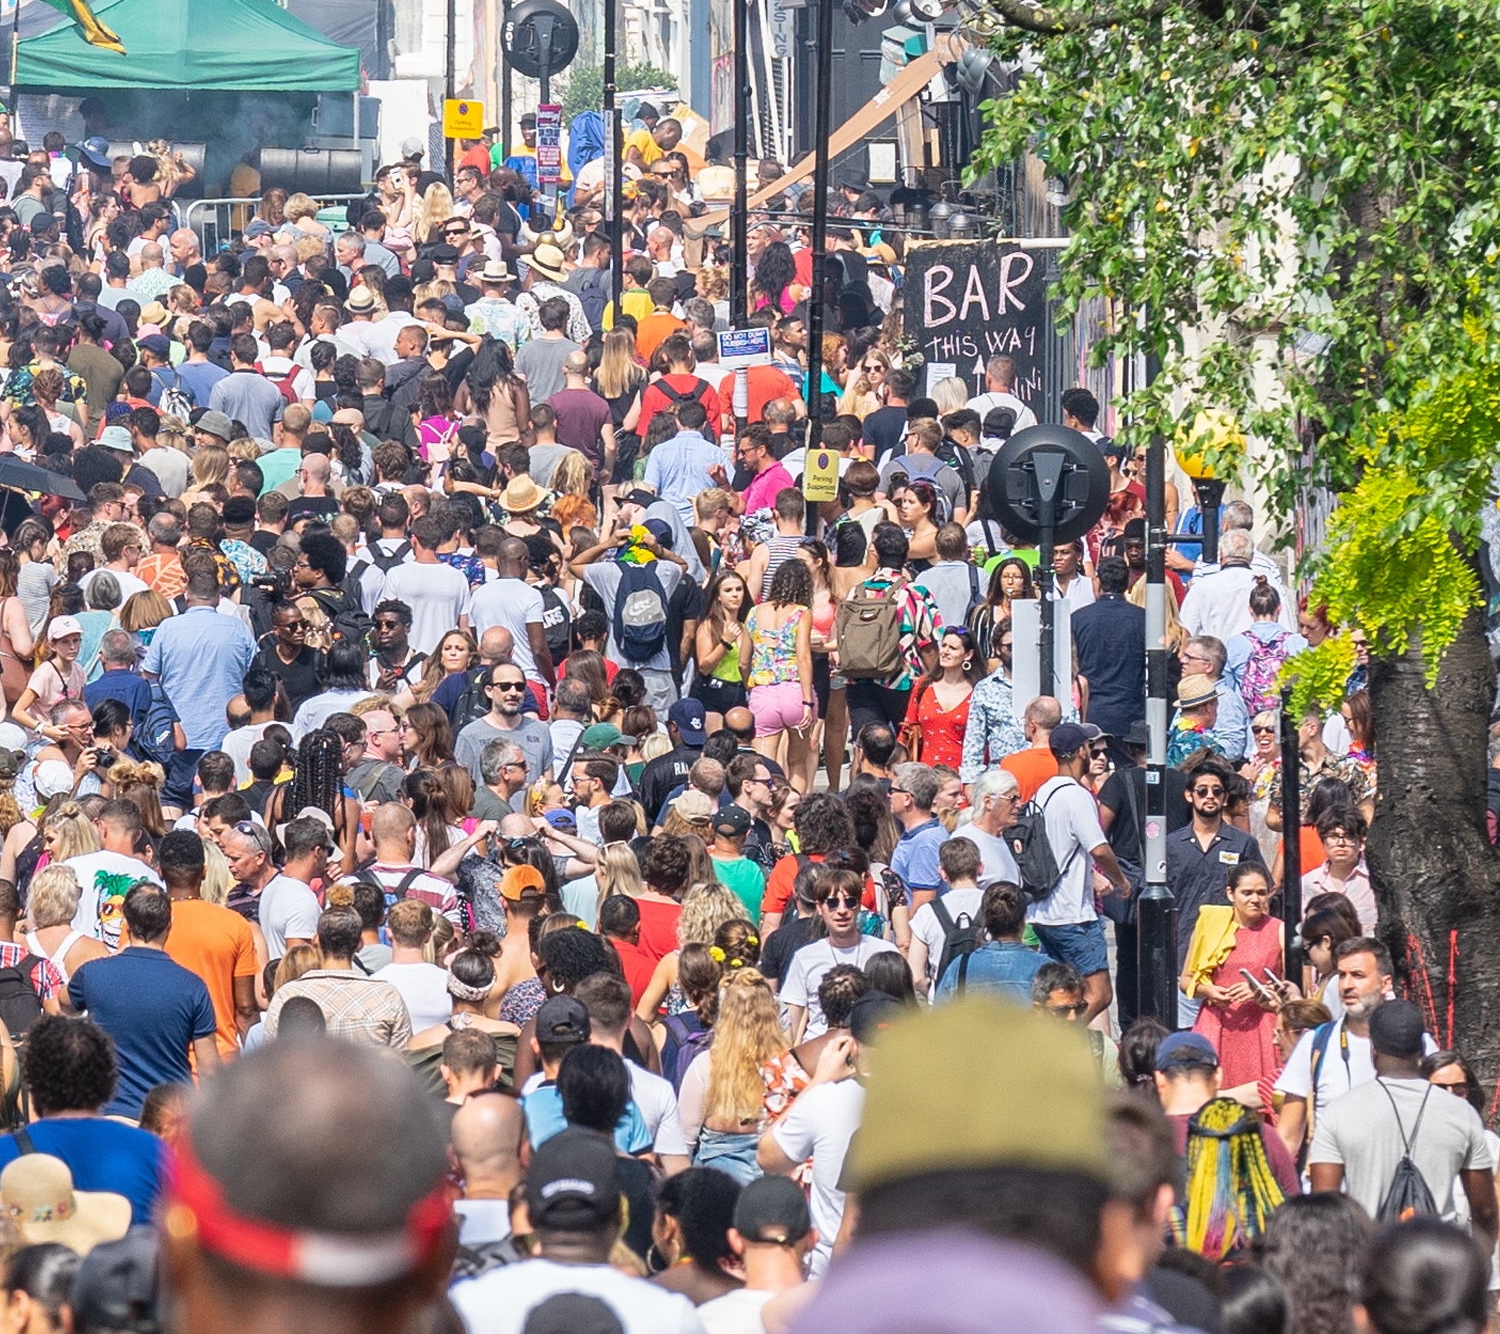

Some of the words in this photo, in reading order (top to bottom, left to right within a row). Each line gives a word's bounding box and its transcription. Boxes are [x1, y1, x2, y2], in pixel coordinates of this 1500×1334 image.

[923, 251, 1034, 328] BAR
[721, 333, 733, 341] DO
[733, 332, 747, 340] NOT
[984, 326, 1036, 357] WAY
